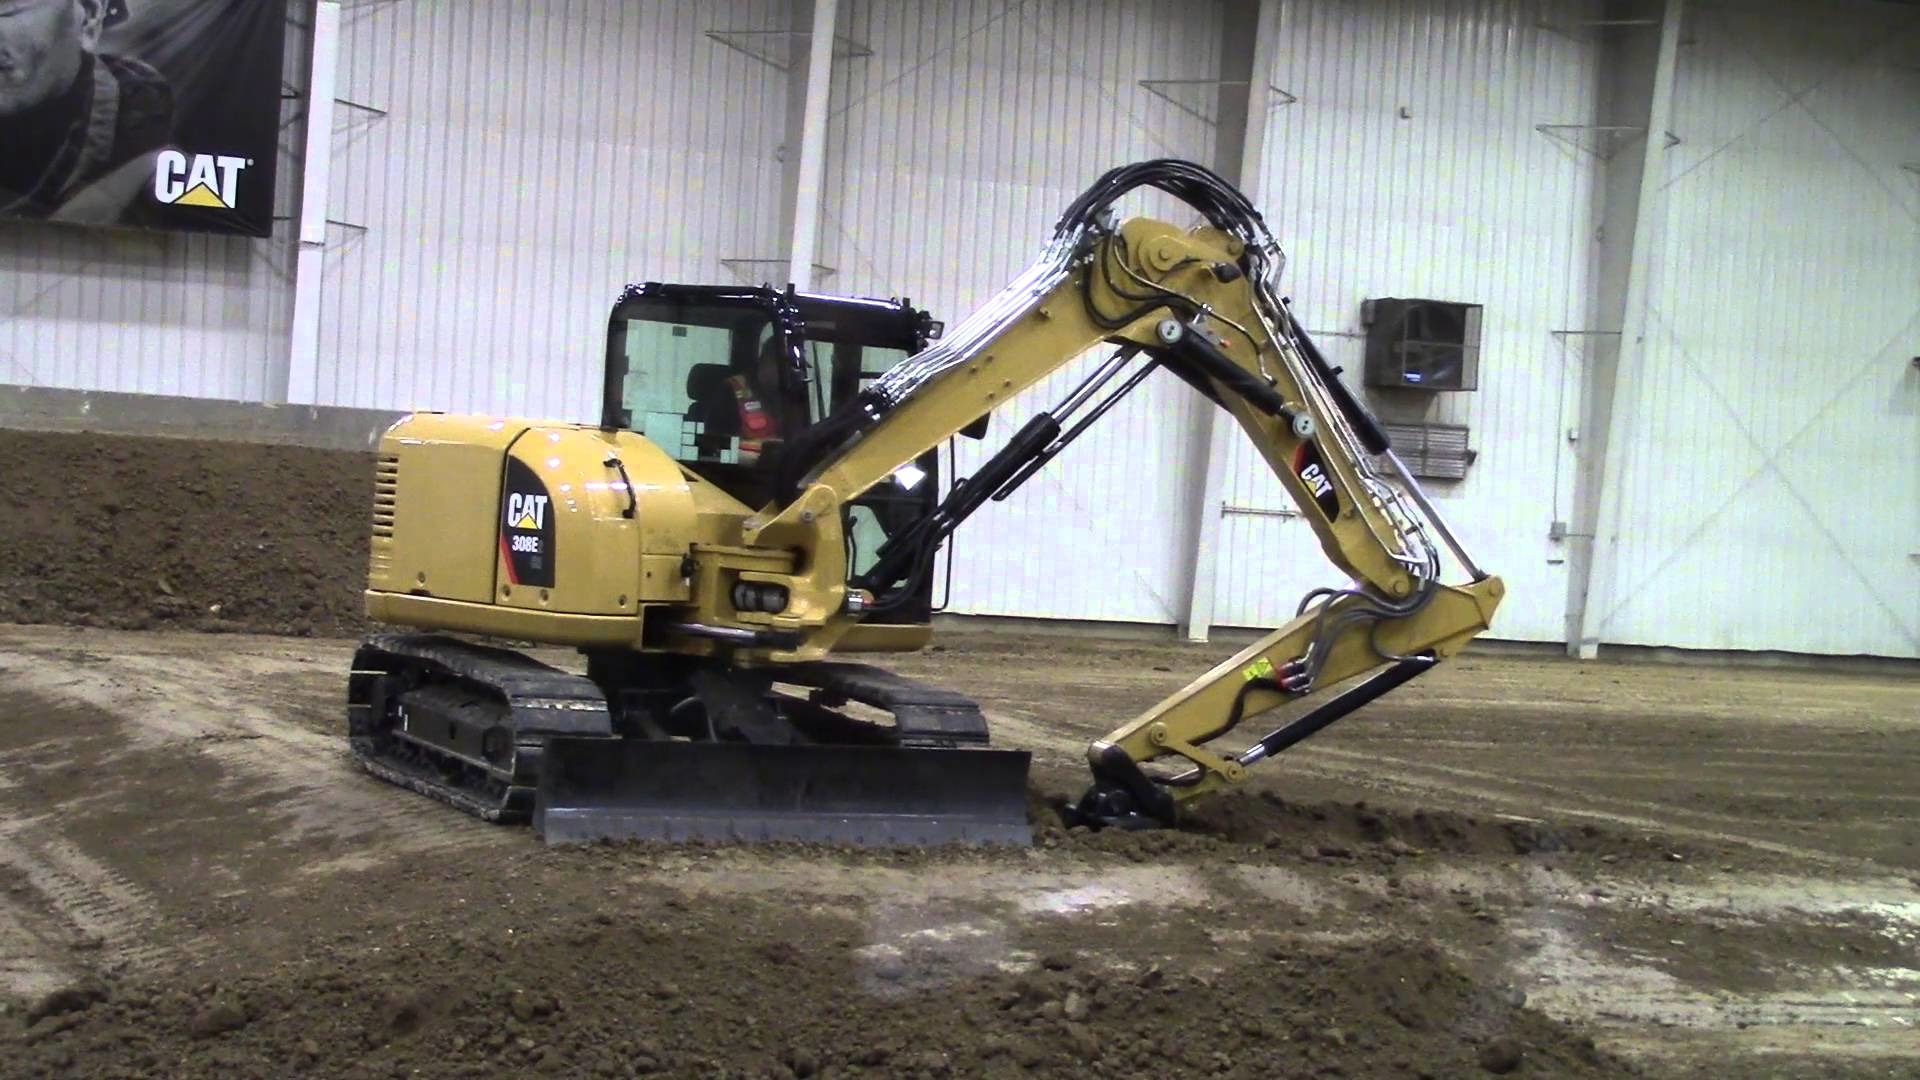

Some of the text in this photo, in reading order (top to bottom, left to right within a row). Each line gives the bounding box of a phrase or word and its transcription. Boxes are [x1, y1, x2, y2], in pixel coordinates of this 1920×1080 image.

[155, 150, 246, 209] CAT
[1301, 463, 1333, 498] CAT
[507, 492, 548, 530] CAT
